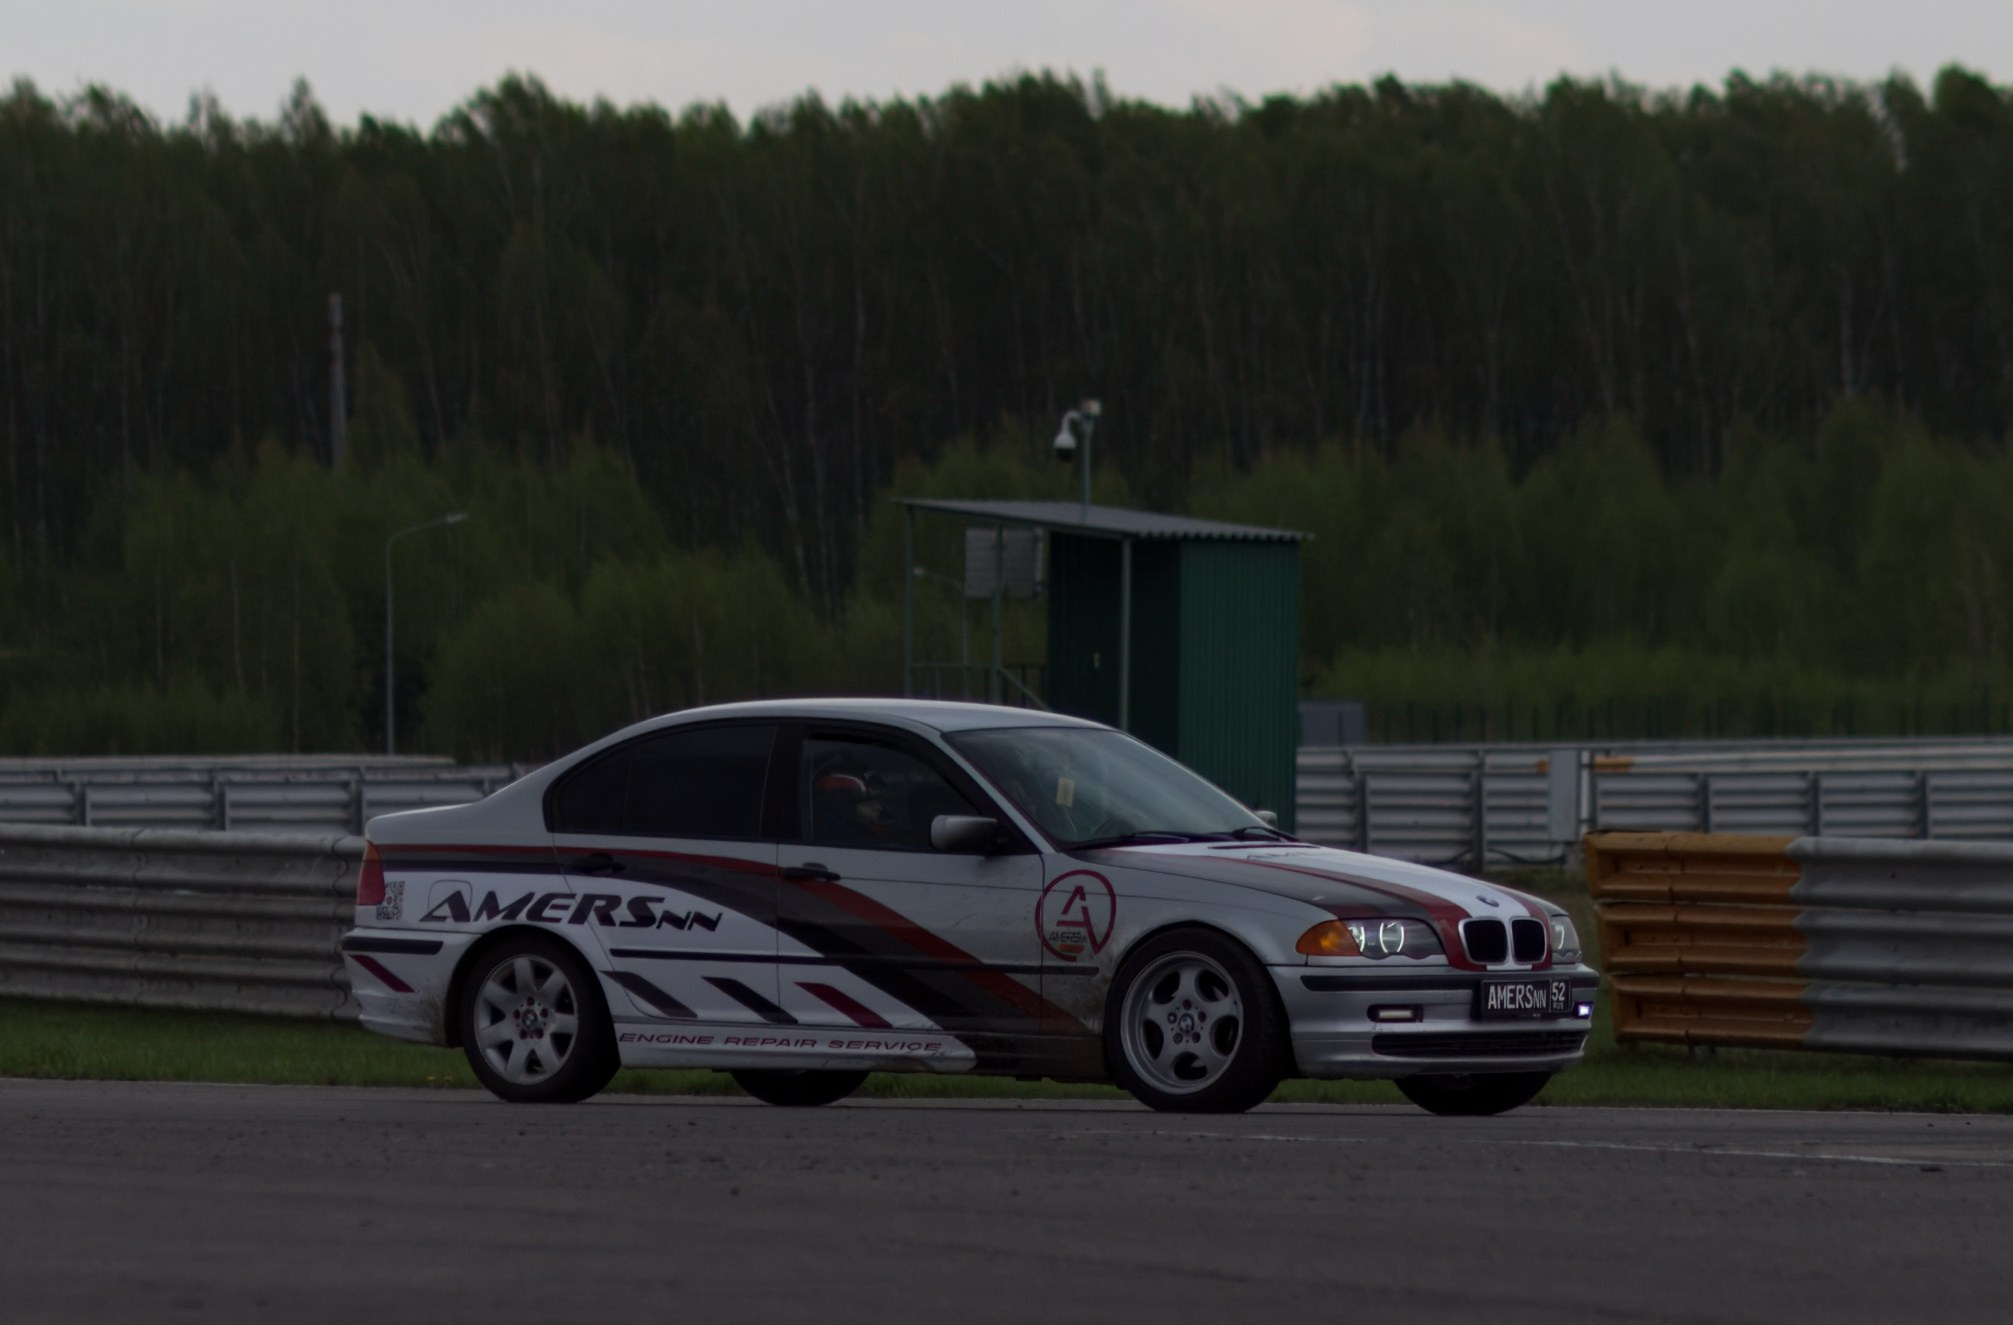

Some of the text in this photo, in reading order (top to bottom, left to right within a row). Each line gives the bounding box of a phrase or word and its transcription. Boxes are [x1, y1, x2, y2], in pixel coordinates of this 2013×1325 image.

[1552, 982, 1566, 1002] 52
[619, 1033, 942, 1051] ENGINE REPAIR SERVICE
